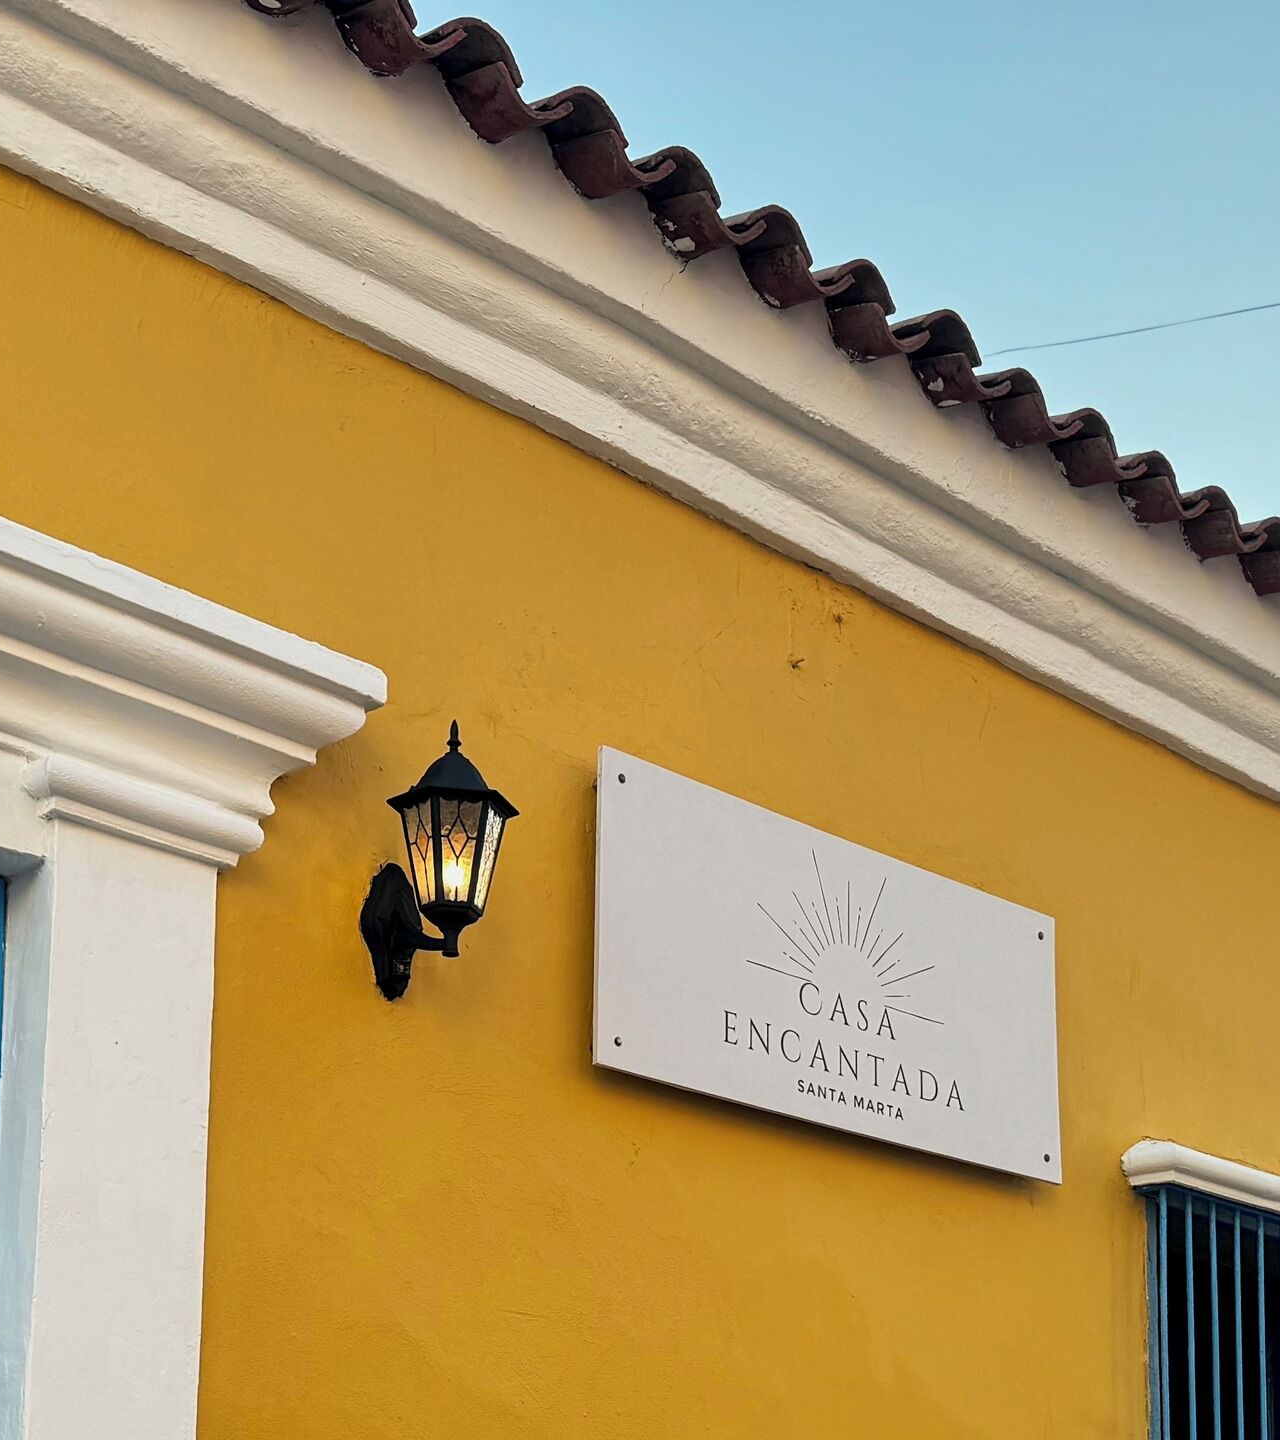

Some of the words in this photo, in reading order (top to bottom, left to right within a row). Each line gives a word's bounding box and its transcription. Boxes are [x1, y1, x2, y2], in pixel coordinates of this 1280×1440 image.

[799, 982, 897, 1041] CASA
[722, 1009, 966, 1112] ENCANTADA
[796, 1078, 848, 1105] SANTA
[852, 1094, 905, 1121] MARTA
